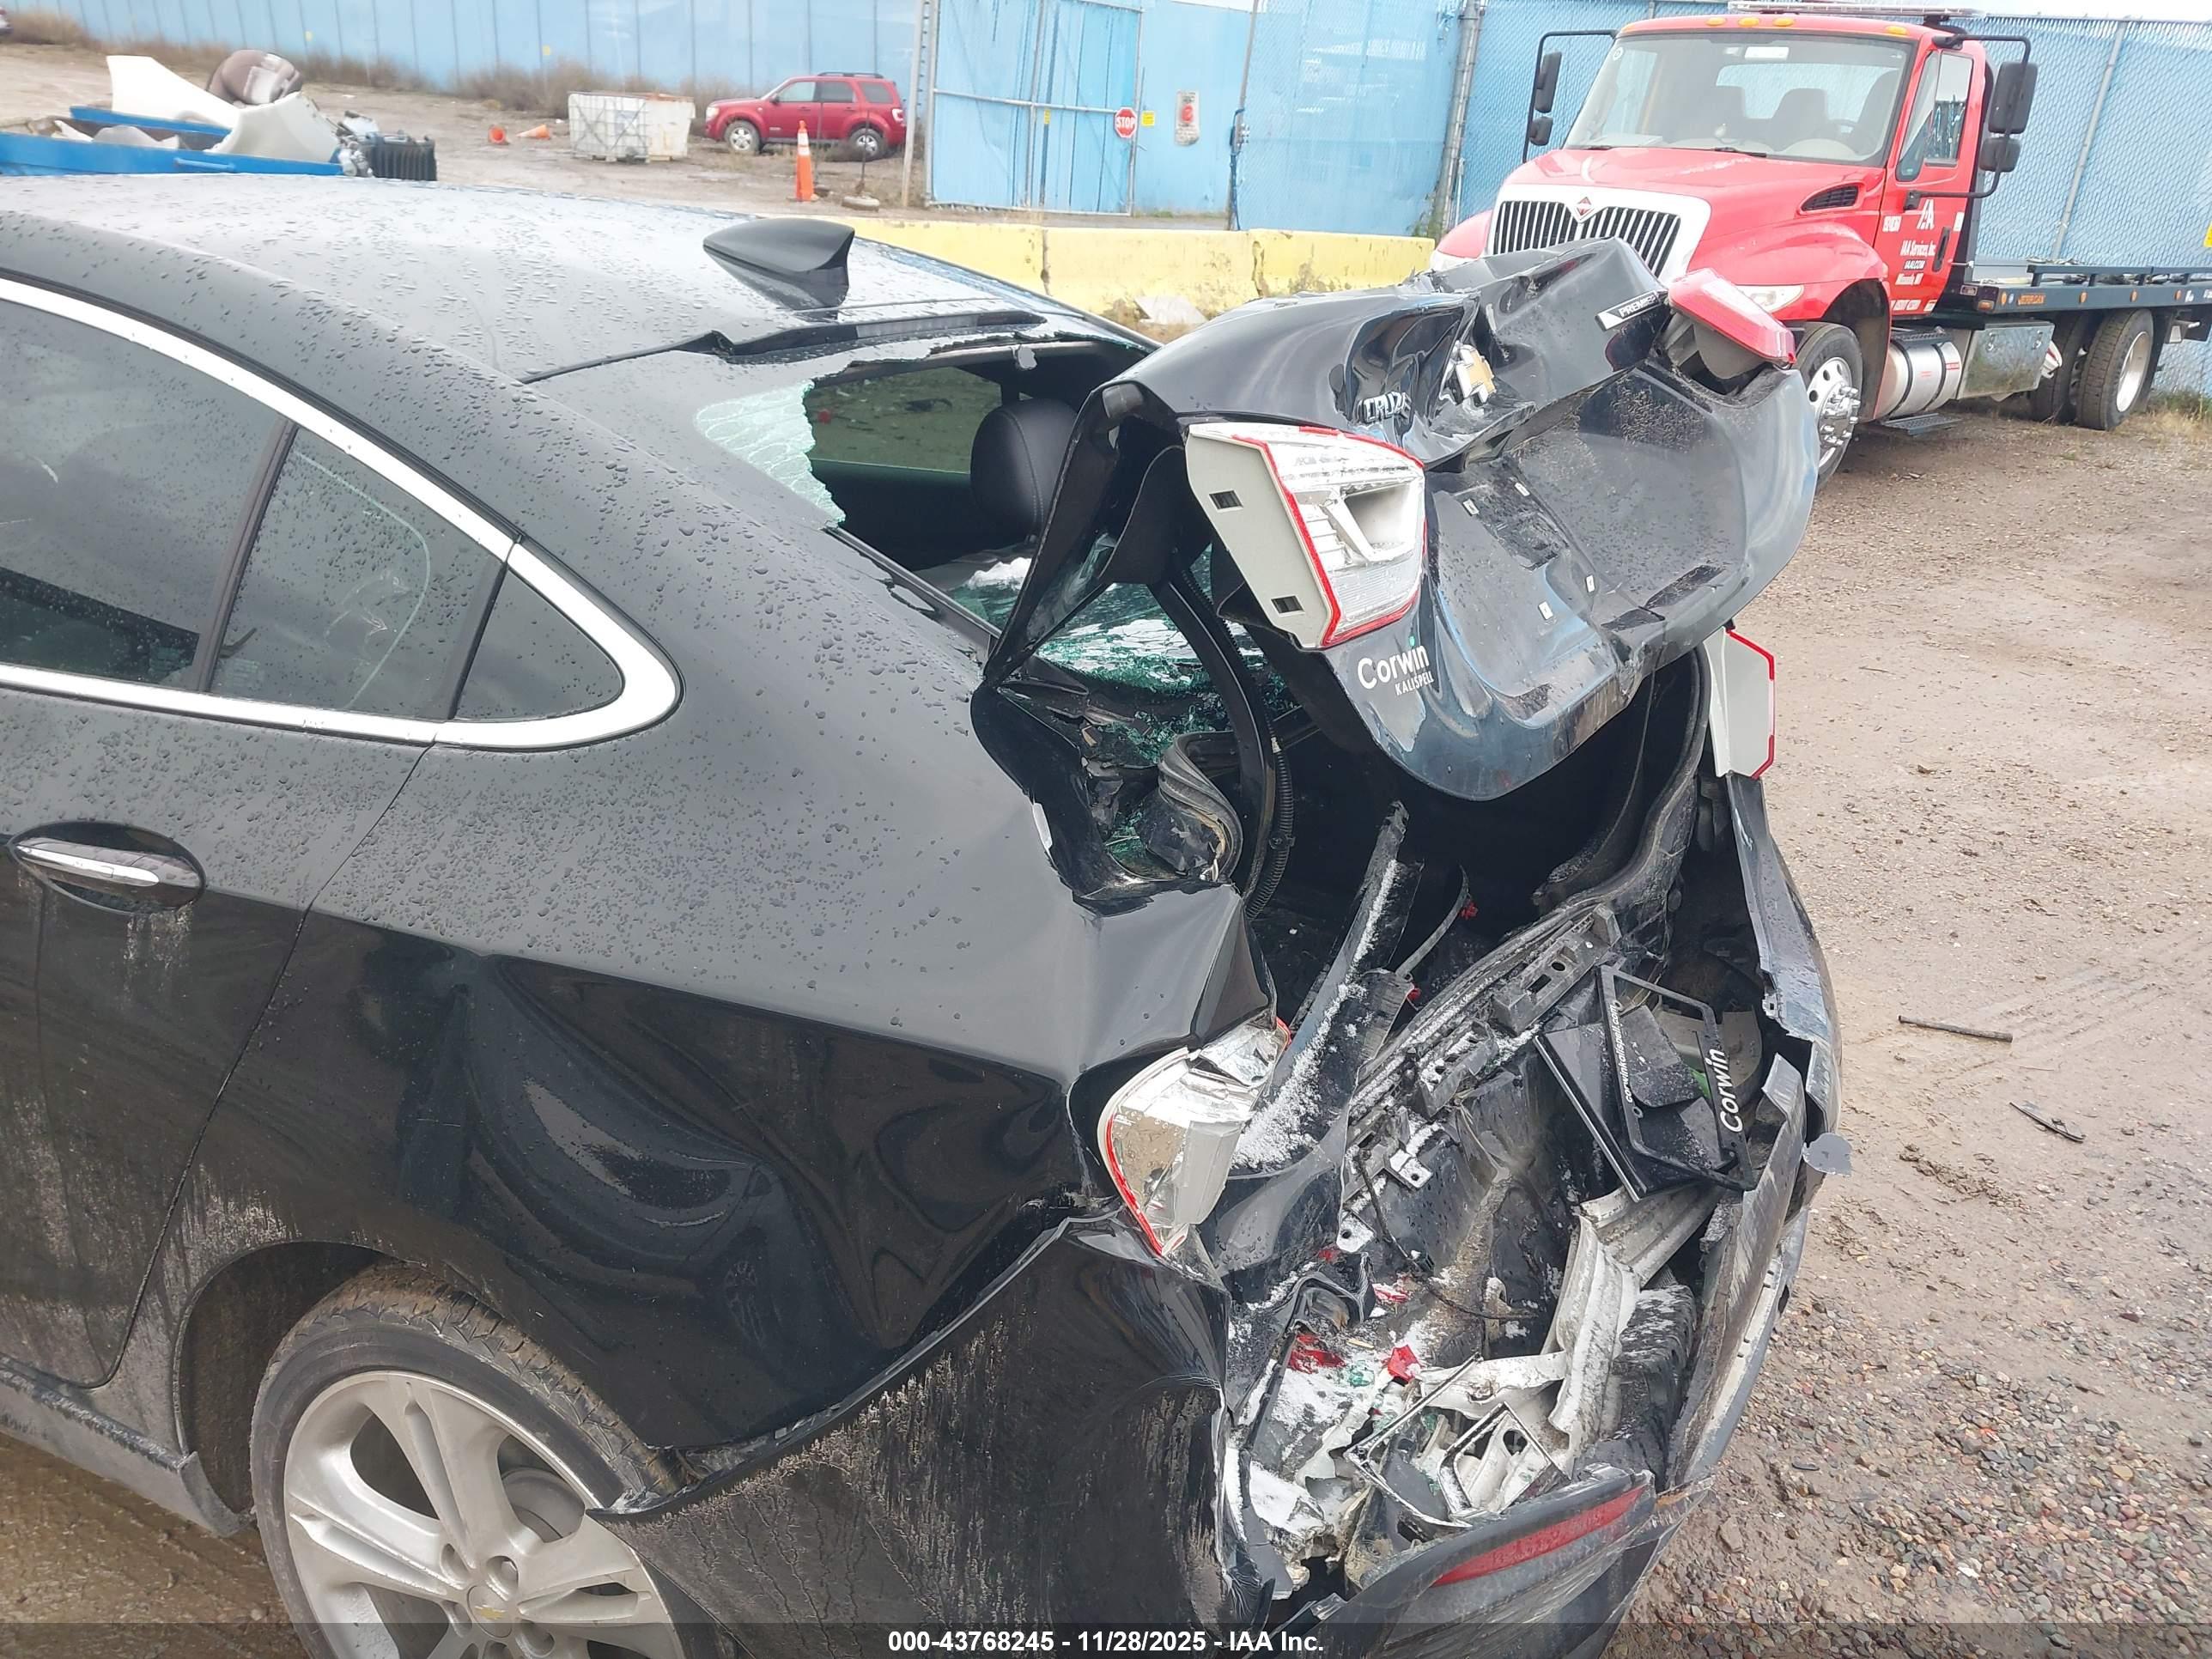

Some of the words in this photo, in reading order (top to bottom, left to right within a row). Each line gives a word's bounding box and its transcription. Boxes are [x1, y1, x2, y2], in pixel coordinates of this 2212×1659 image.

[1116, 115, 1135, 129] STOP
[1358, 635, 1430, 690] Corwin
[1395, 671, 1435, 696] KALISPELL
[1610, 1004, 1633, 1103] corwinkalispell.com
[1705, 1048, 1743, 1133] Corwin
